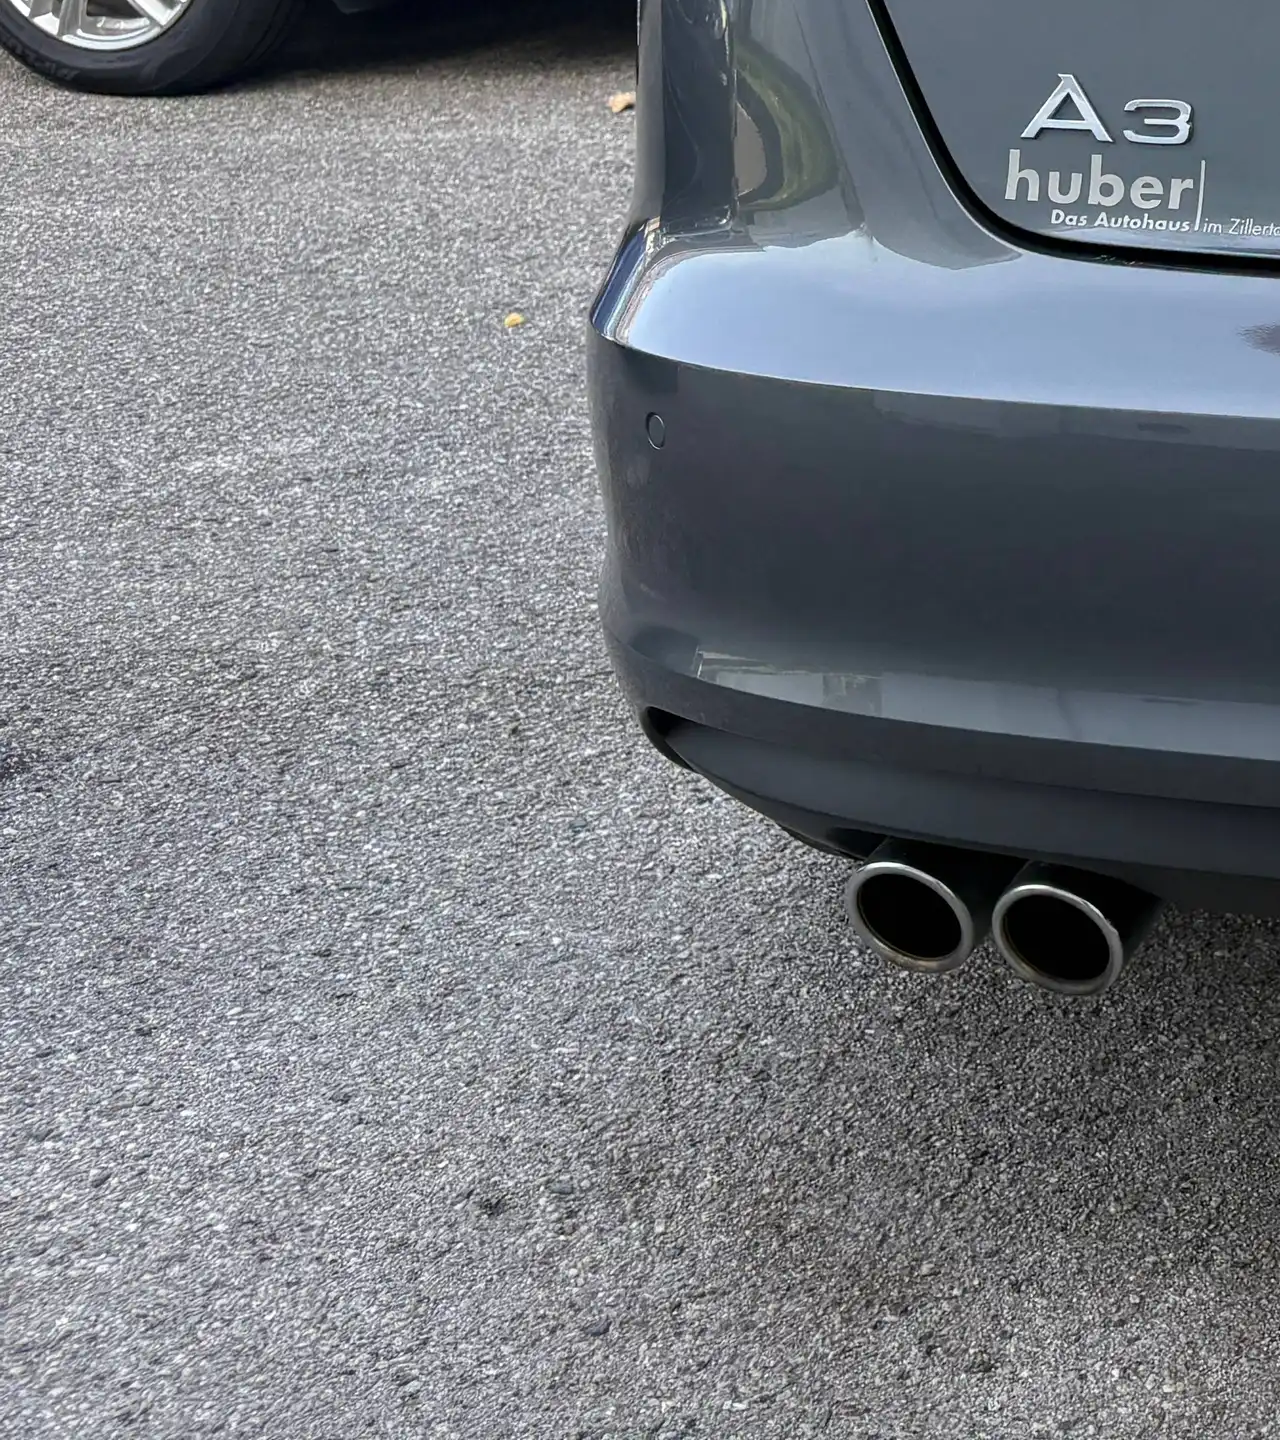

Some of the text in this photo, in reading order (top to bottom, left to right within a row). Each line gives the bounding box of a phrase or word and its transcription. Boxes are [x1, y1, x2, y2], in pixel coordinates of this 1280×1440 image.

[1019, 72, 1194, 146] A3
[1003, 148, 1194, 210] huber
[1050, 208, 1088, 227] Das
[1093, 210, 1191, 233] Autohaus
[1203, 217, 1223, 235] im
